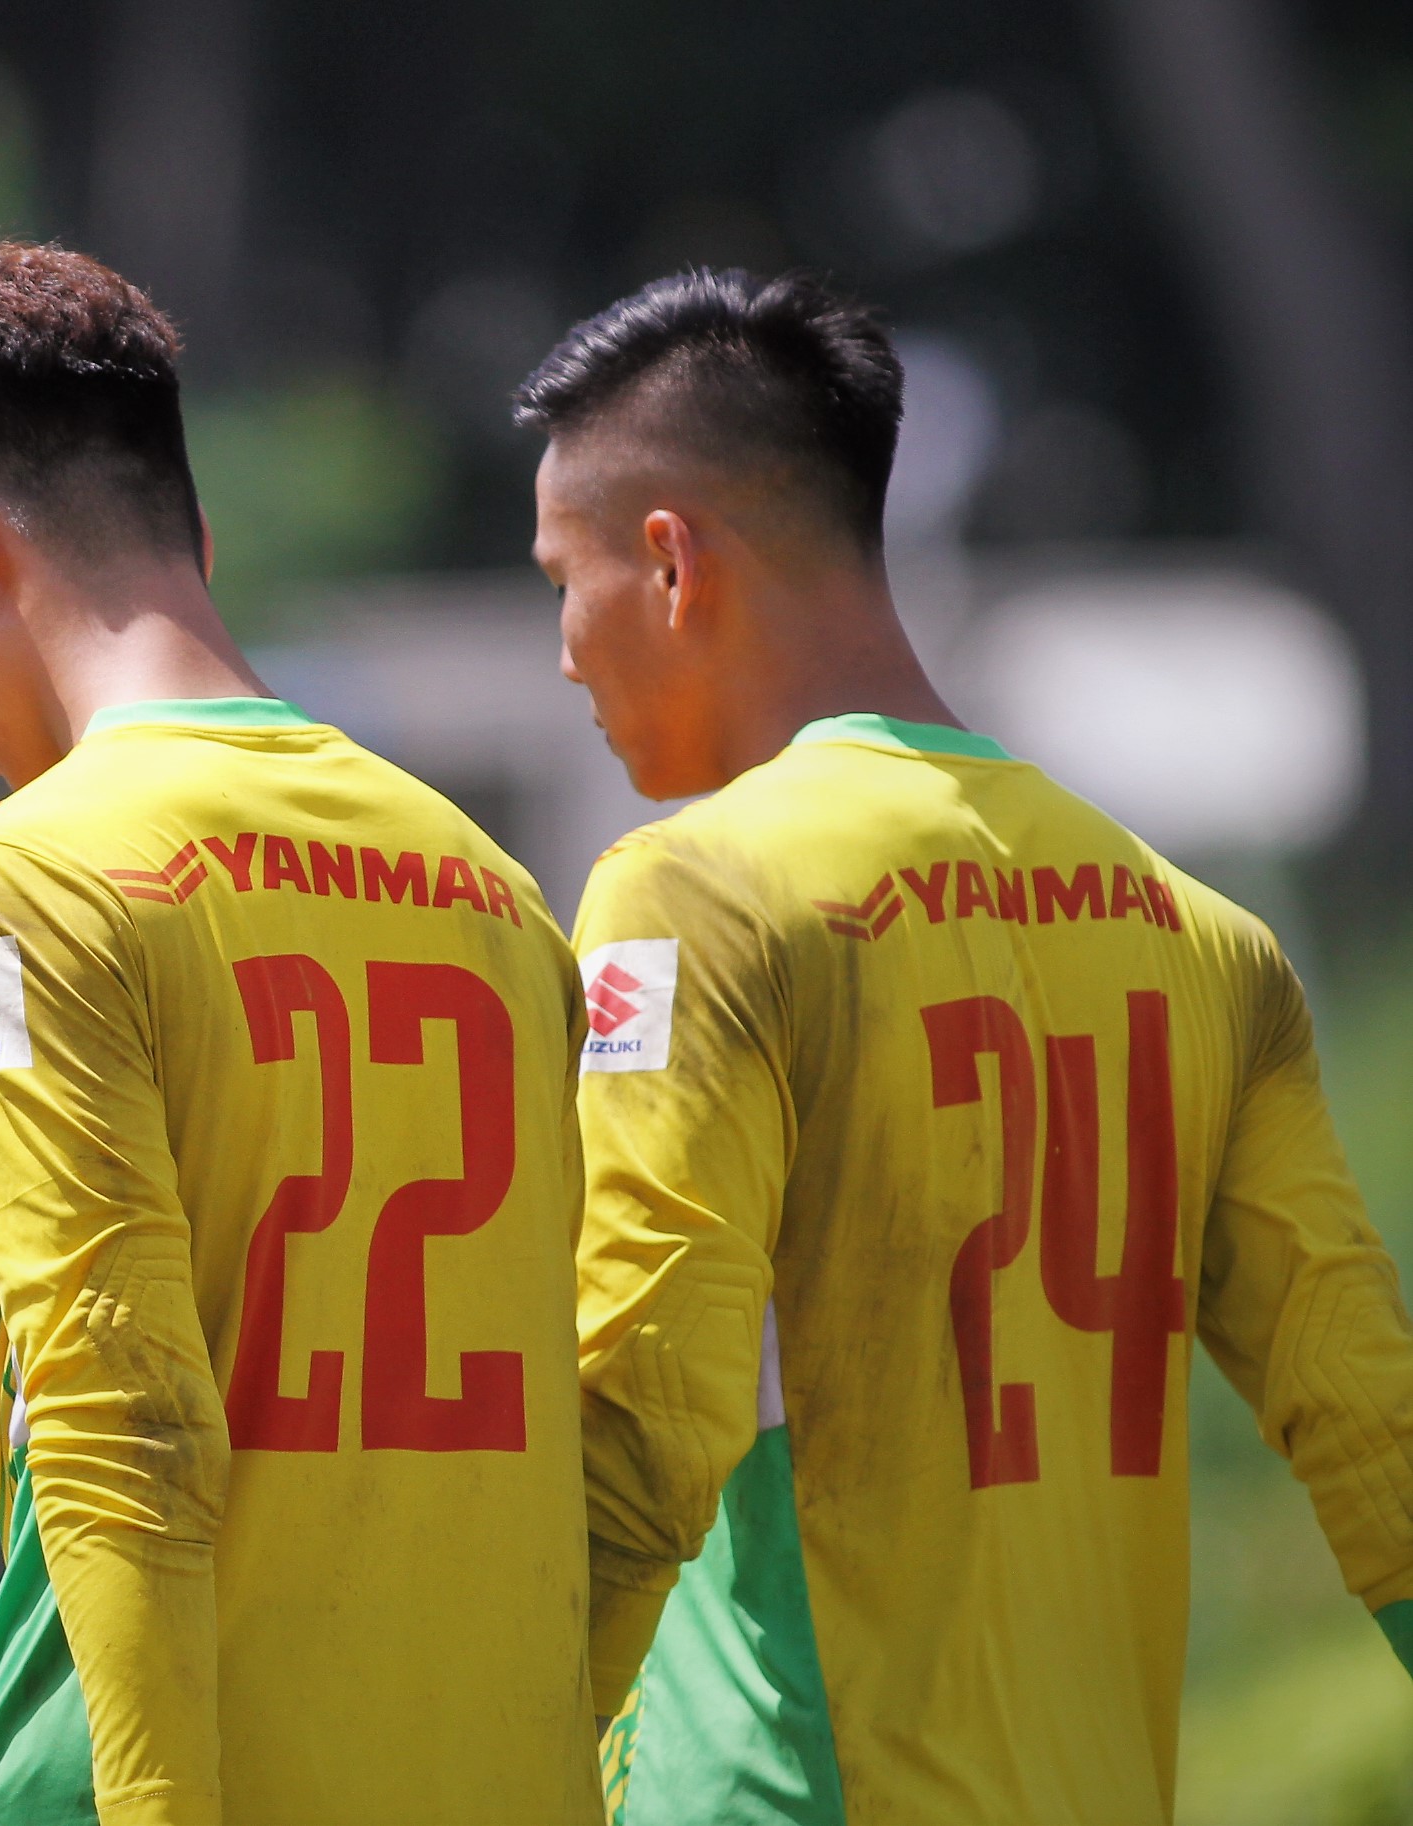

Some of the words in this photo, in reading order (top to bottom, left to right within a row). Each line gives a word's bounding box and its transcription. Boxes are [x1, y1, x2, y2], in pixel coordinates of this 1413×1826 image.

[200, 832, 524, 929] YANMAR
[897, 861, 1182, 932] YANMAR
[584, 1039, 642, 1054] UZUKI
[225, 952, 527, 1453] 22
[919, 990, 1186, 1490] 24
